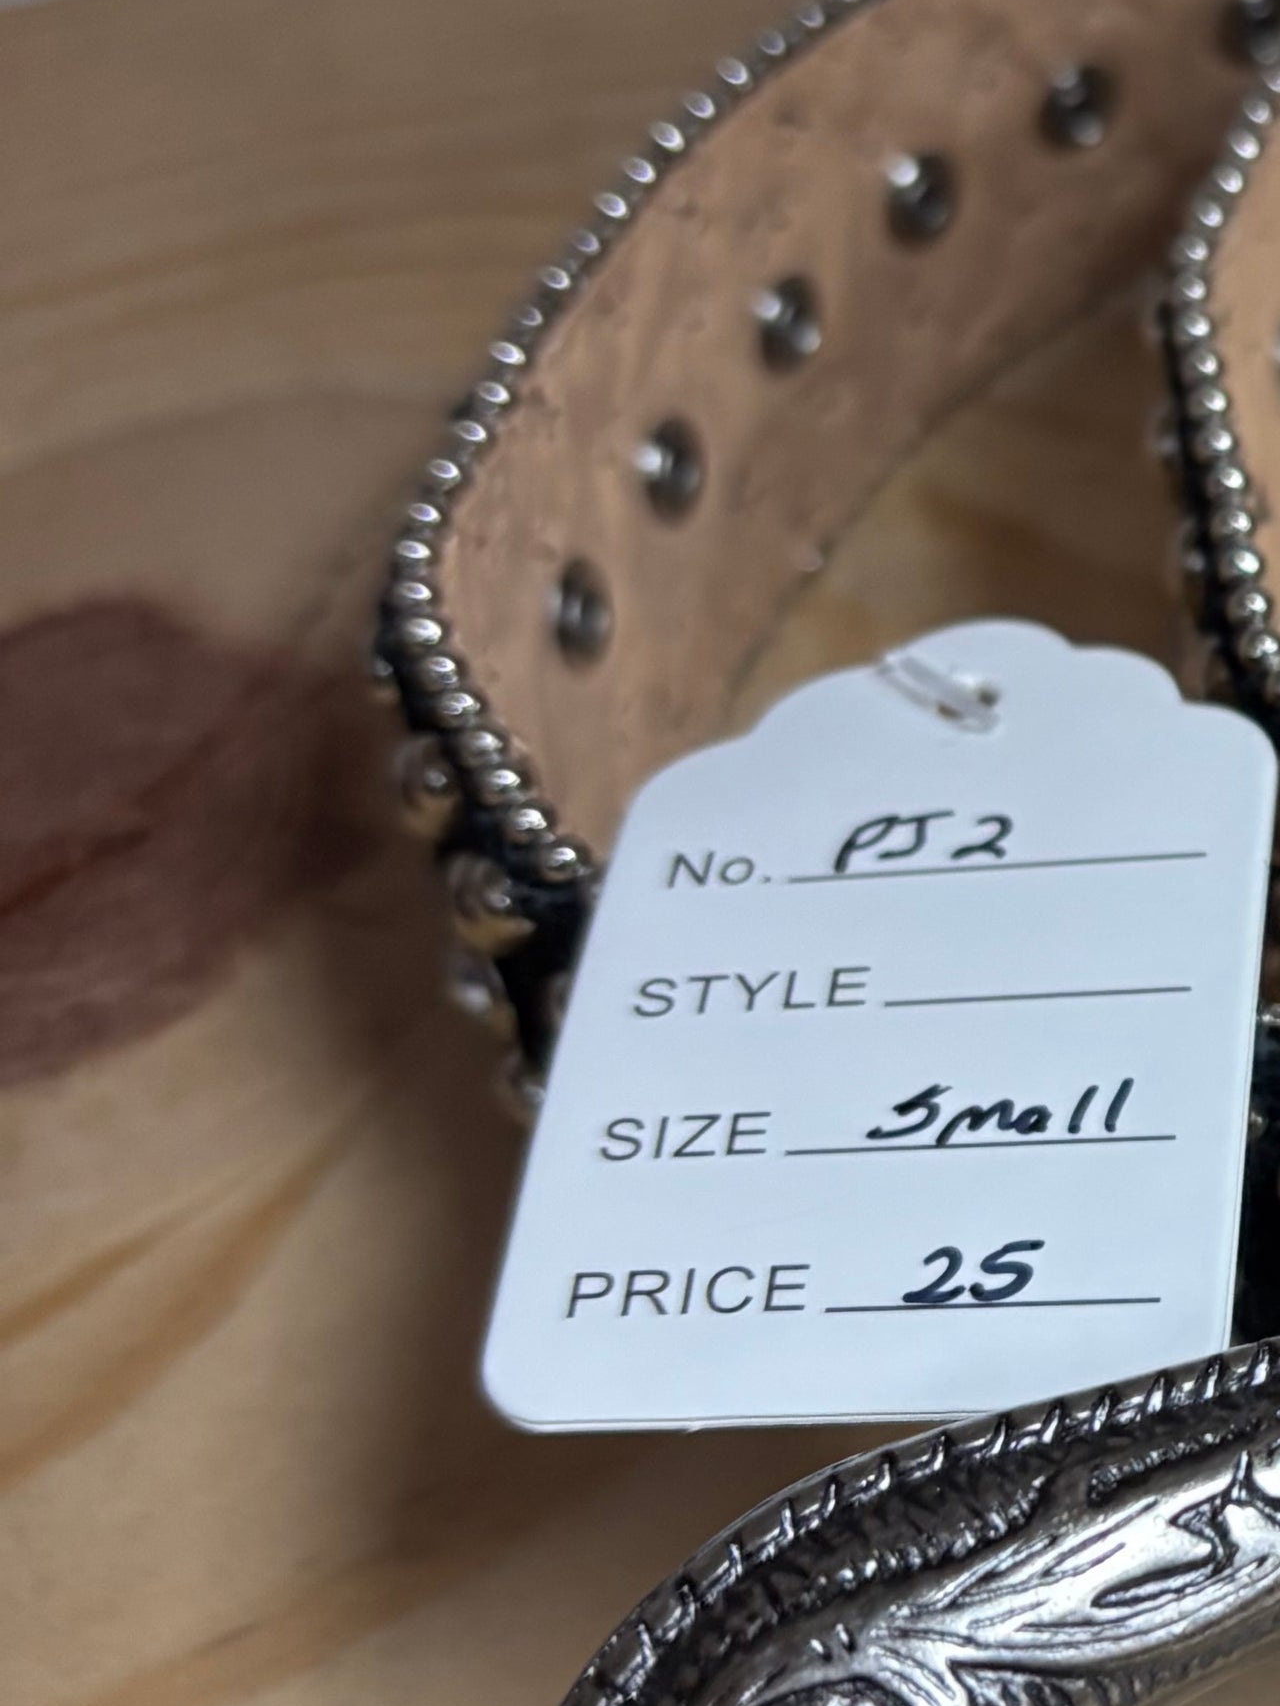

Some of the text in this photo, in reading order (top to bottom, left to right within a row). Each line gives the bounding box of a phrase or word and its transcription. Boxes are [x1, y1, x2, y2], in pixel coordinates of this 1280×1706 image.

[666, 849, 772, 888] No.
[632, 966, 872, 1018] STYLE
[599, 1077, 1135, 1161] SIZE Small
[564, 1240, 1045, 1319] PRICE 25
